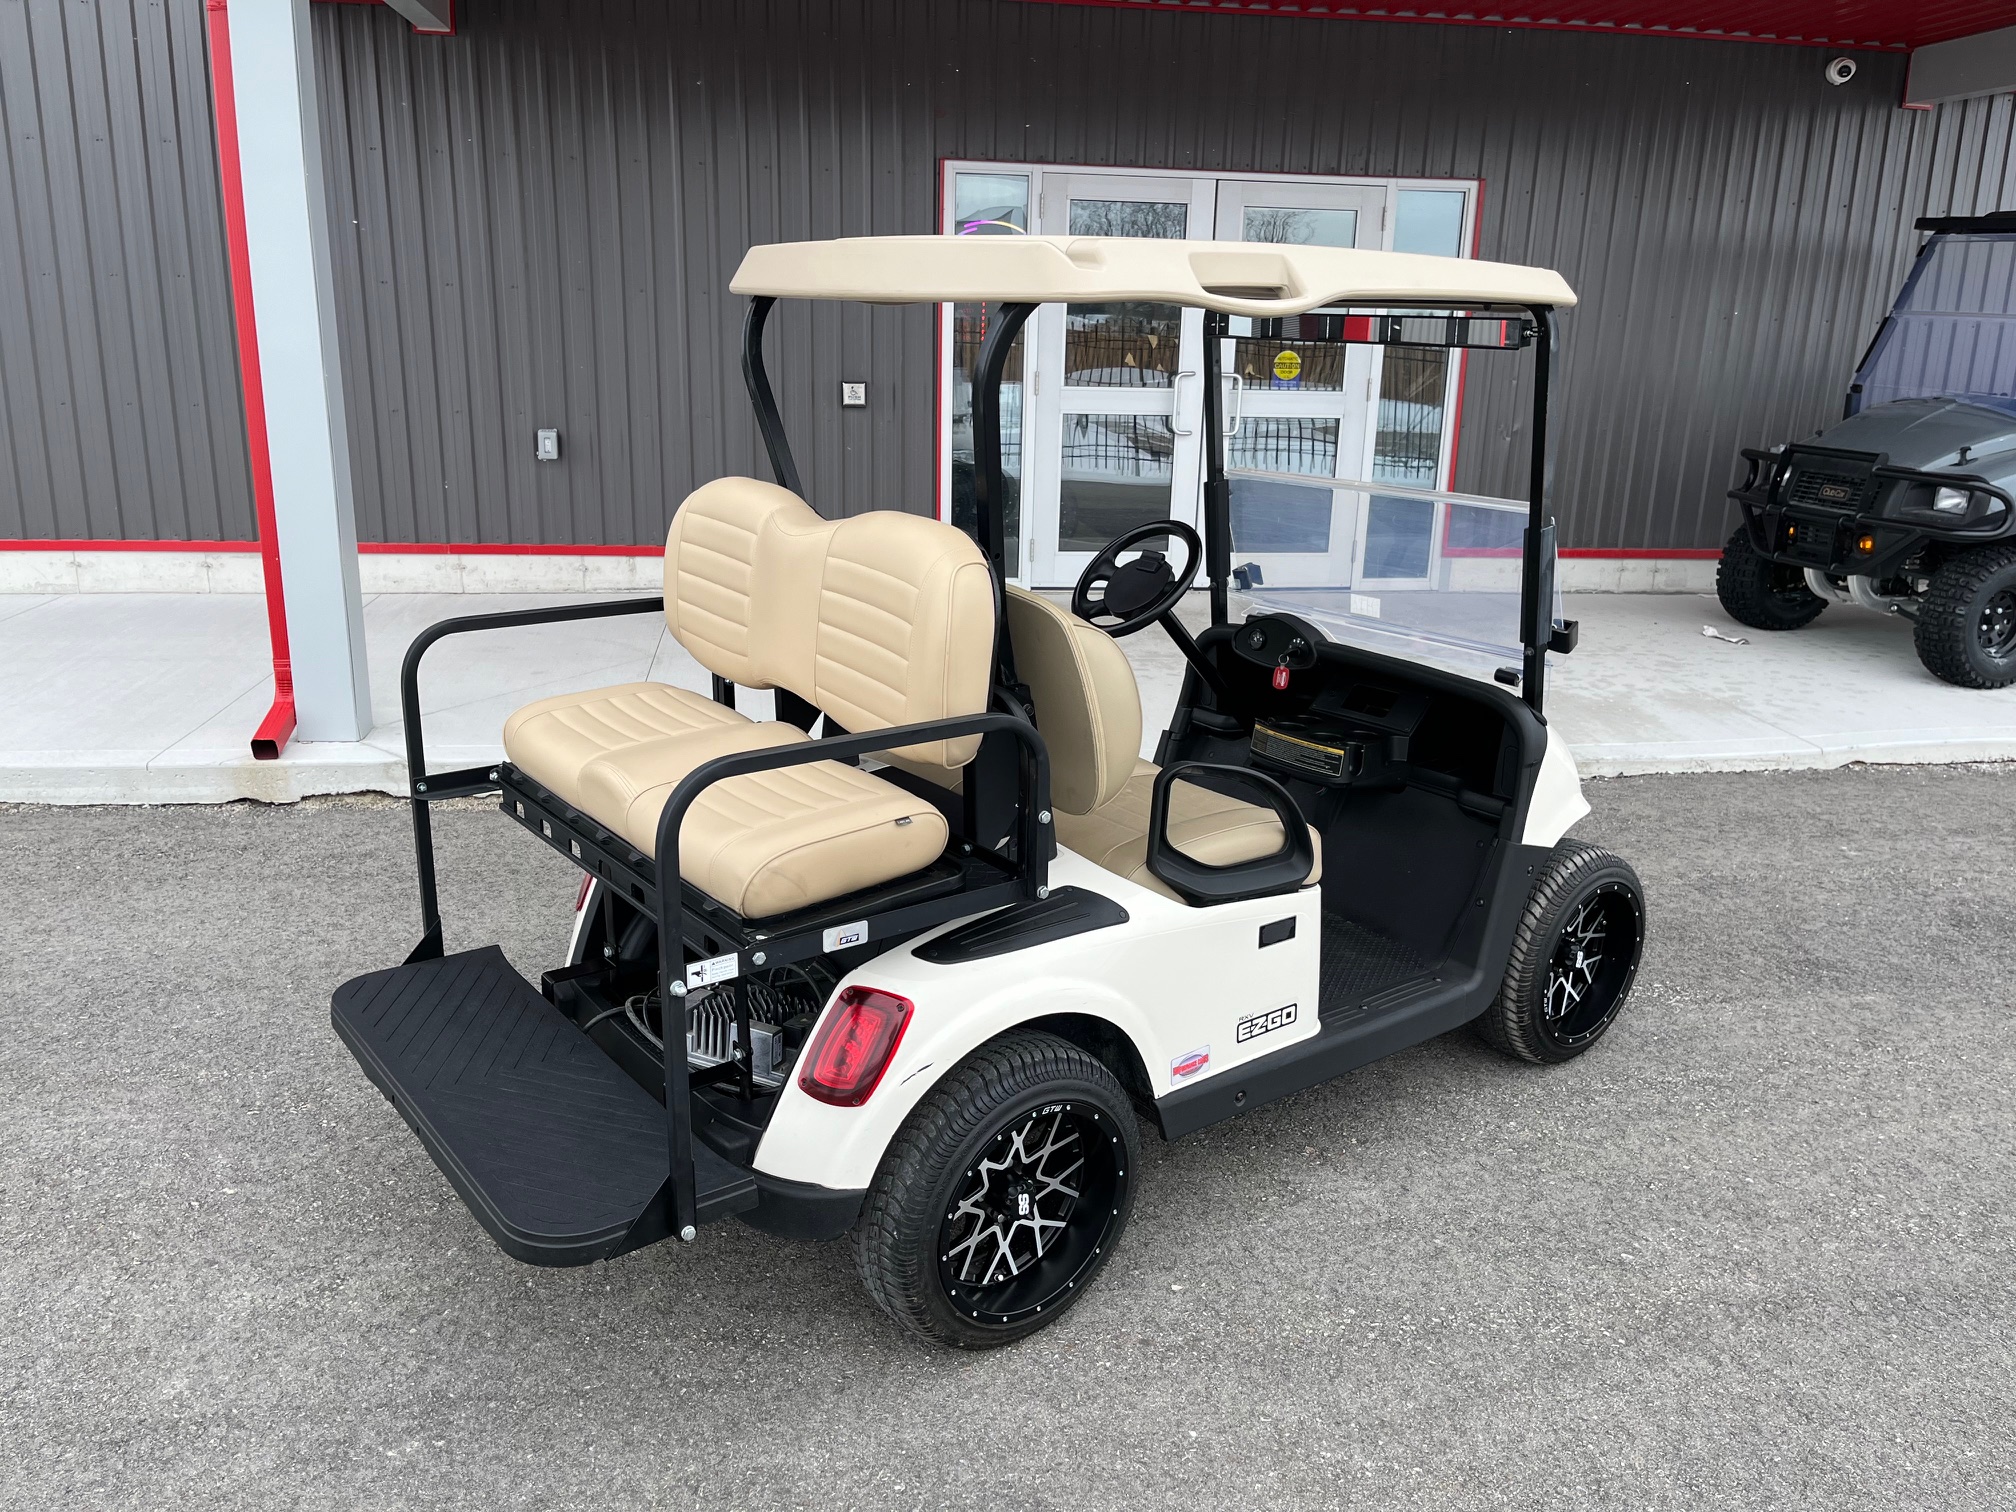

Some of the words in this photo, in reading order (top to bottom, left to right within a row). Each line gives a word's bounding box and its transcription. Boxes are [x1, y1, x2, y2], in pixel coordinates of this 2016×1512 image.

[1238, 1012, 1255, 1022] RXV
[1041, 1104, 1063, 1115] GTW
[1018, 1193, 1030, 1215] SS
